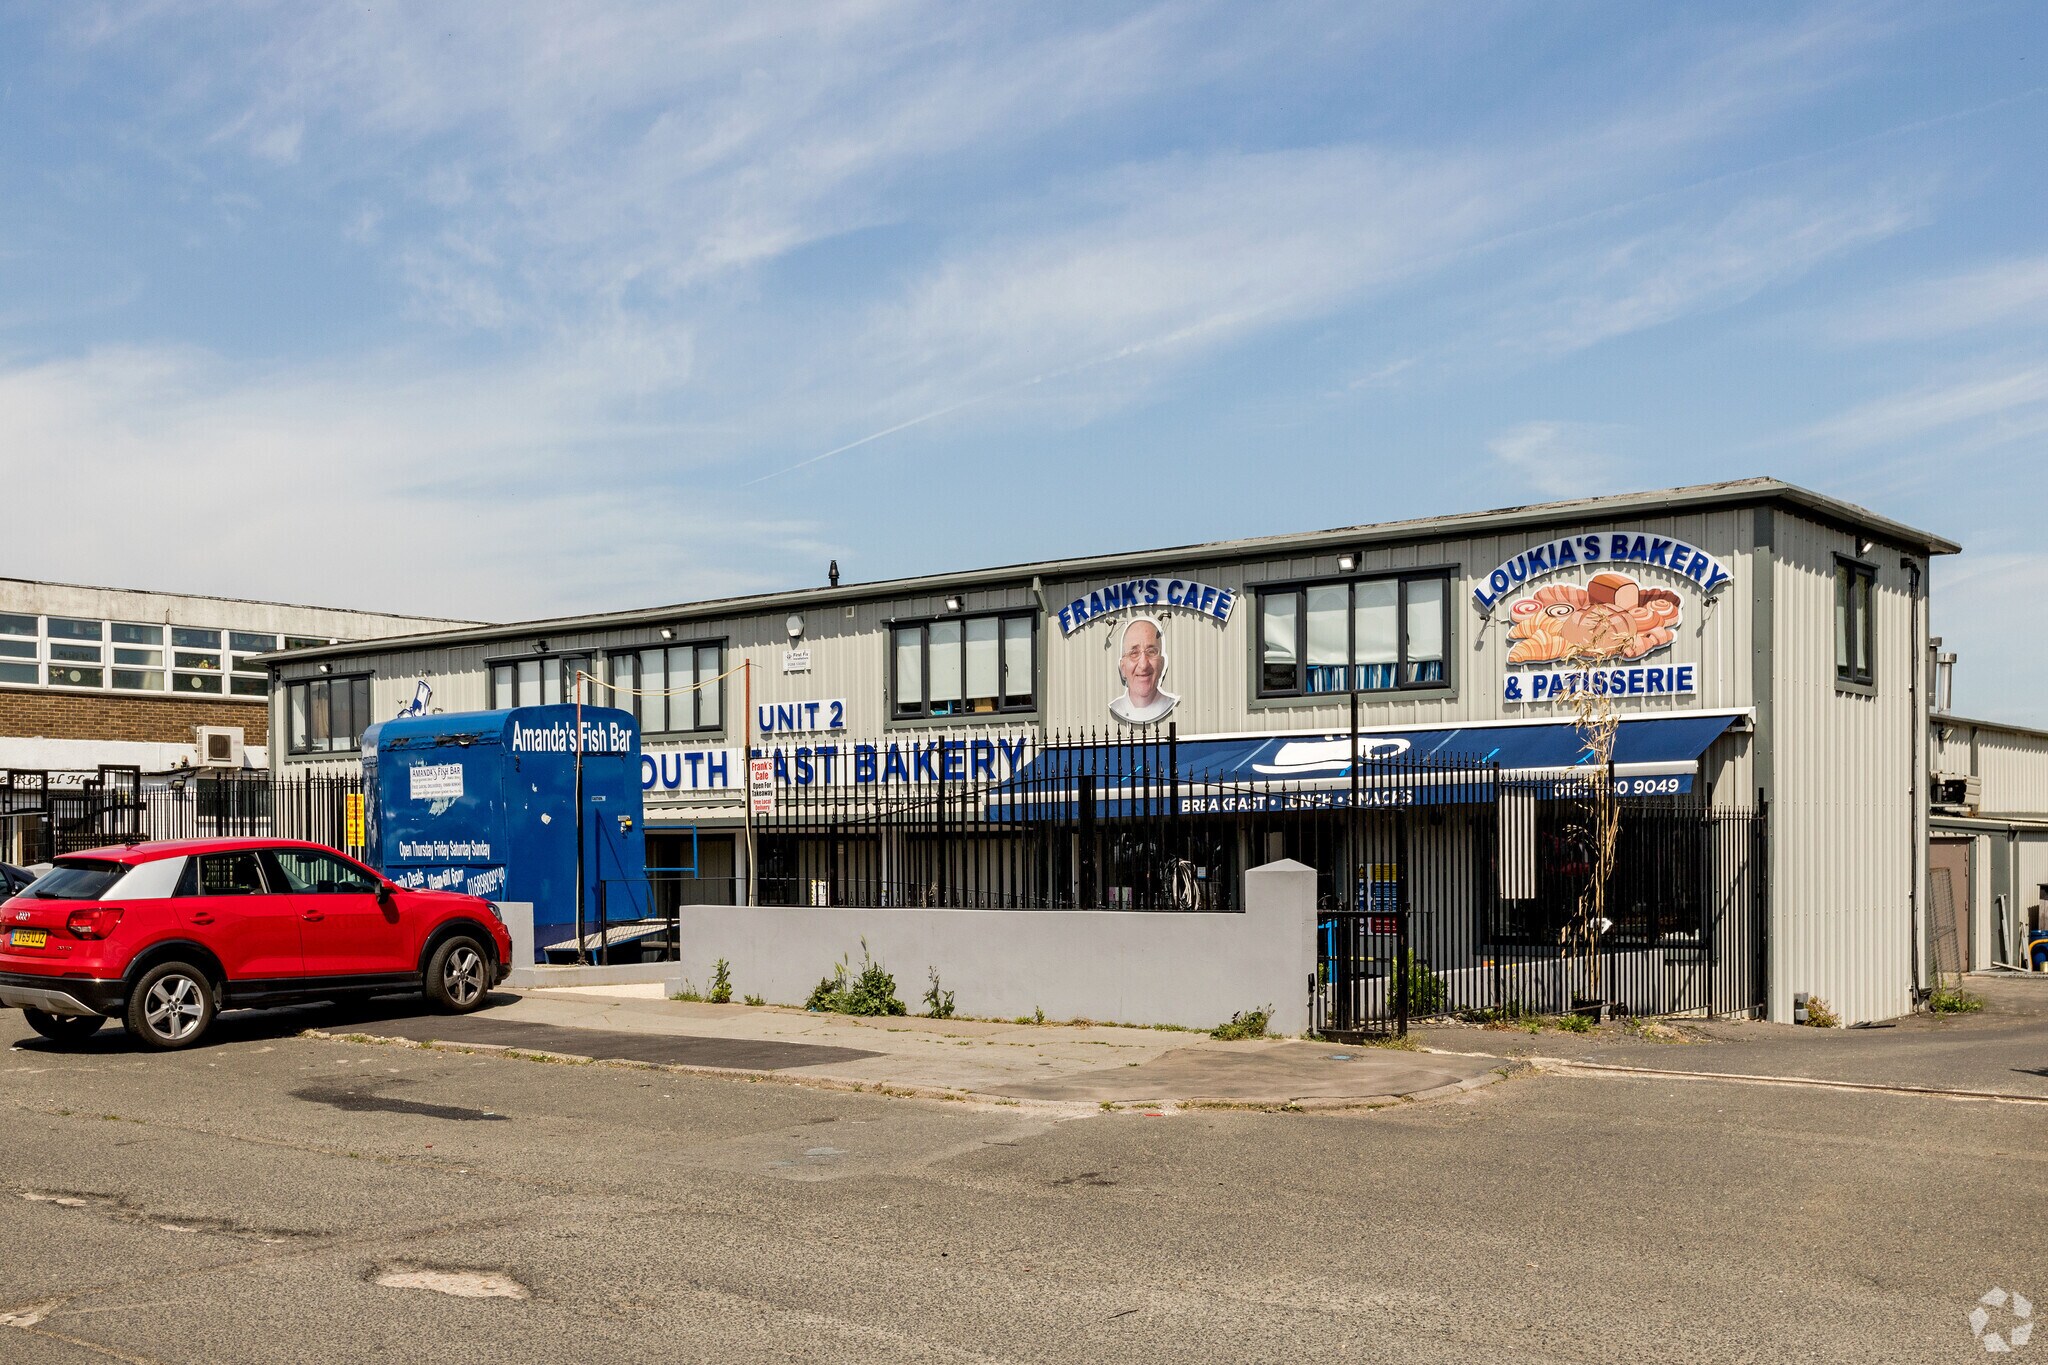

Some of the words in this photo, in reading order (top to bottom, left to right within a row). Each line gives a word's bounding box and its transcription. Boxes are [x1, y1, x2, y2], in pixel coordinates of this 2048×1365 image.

[1475, 534, 1600, 607] LOUKIA'S
[1611, 534, 1728, 591] BAKERY
[1058, 579, 1159, 633] FRANK'S
[1167, 580, 1236, 620] CAFÉ
[1504, 675, 1523, 700] &
[1533, 666, 1693, 699] PATISSERIE
[759, 702, 820, 732] UNIT
[830, 701, 844, 728] 2
[512, 720, 577, 752] Amanda's
[580, 721, 607, 752] Fish
[609, 722, 633, 752] Bar
[641, 751, 728, 790] OUTH
[750, 746, 838, 785] AST
[855, 737, 1027, 783] BAKERY
[751, 762, 773, 771] Frank's
[755, 771, 769, 780] Cafe
[752, 782, 764, 790] Open
[1633, 778, 1679, 795] 9049
[399, 840, 412, 860] Open
[411, 840, 434, 860] Thursday
[433, 840, 449, 860] Friday
[449, 840, 471, 860] Saturday
[471, 840, 491, 860] Sunday
[407, 868, 425, 888] Deals
[450, 867, 464, 888] 6pm
